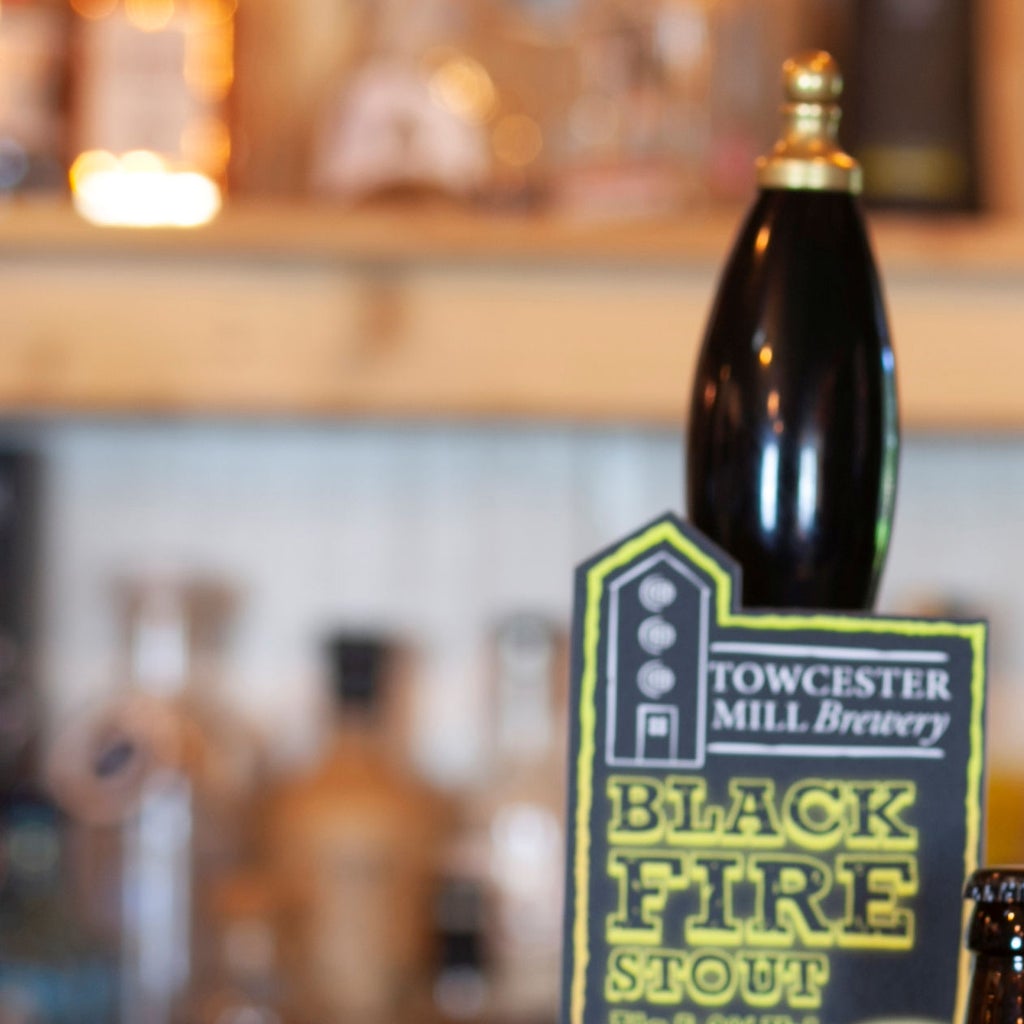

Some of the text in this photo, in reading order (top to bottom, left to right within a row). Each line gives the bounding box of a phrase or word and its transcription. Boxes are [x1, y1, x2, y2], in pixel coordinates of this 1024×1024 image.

[708, 661, 952, 701] TOWCESTER
[711, 701, 950, 747] MILL Brewery
[607, 774, 918, 851] BLACK
[606, 848, 918, 950] FIRE
[605, 947, 830, 1008] STOUT
